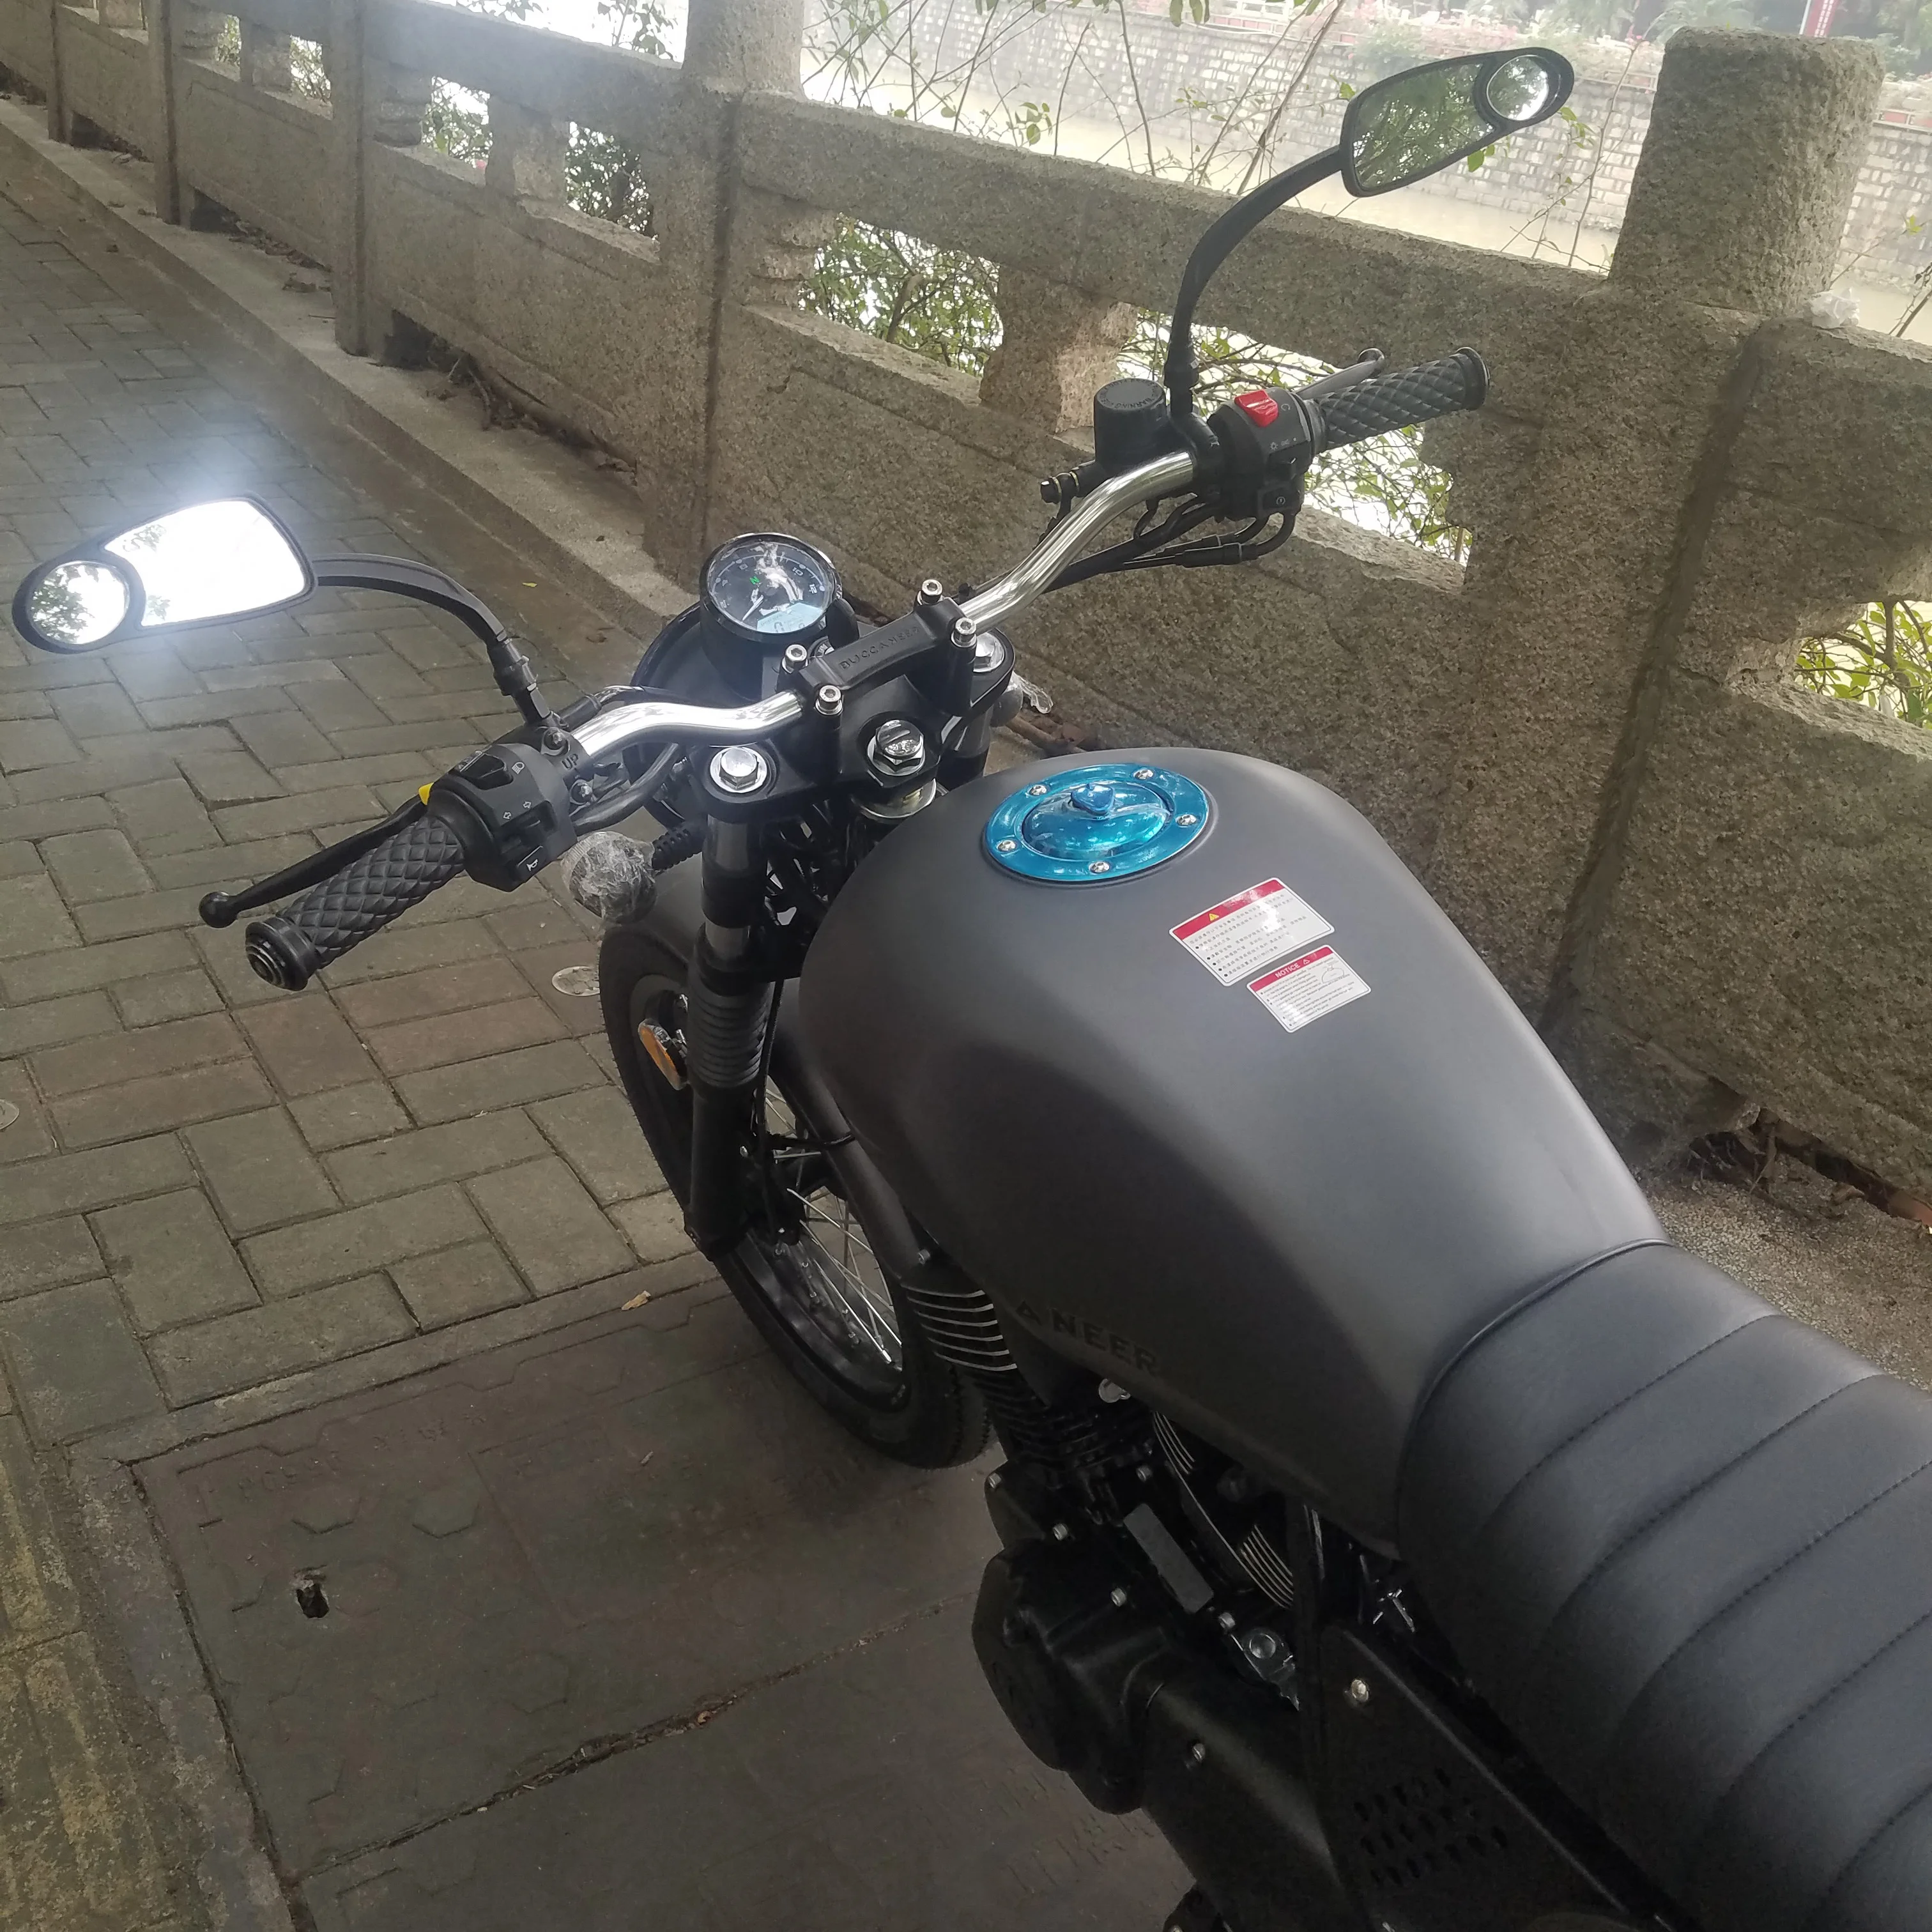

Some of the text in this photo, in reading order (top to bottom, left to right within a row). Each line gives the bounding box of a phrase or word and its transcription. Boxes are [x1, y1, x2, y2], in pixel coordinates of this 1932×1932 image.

[792, 567, 804, 576] 10
[749, 576, 760, 585] N
[809, 583, 817, 594] 12
[562, 753, 579, 769] UP
[1275, 963, 1301, 979] NOTICE
